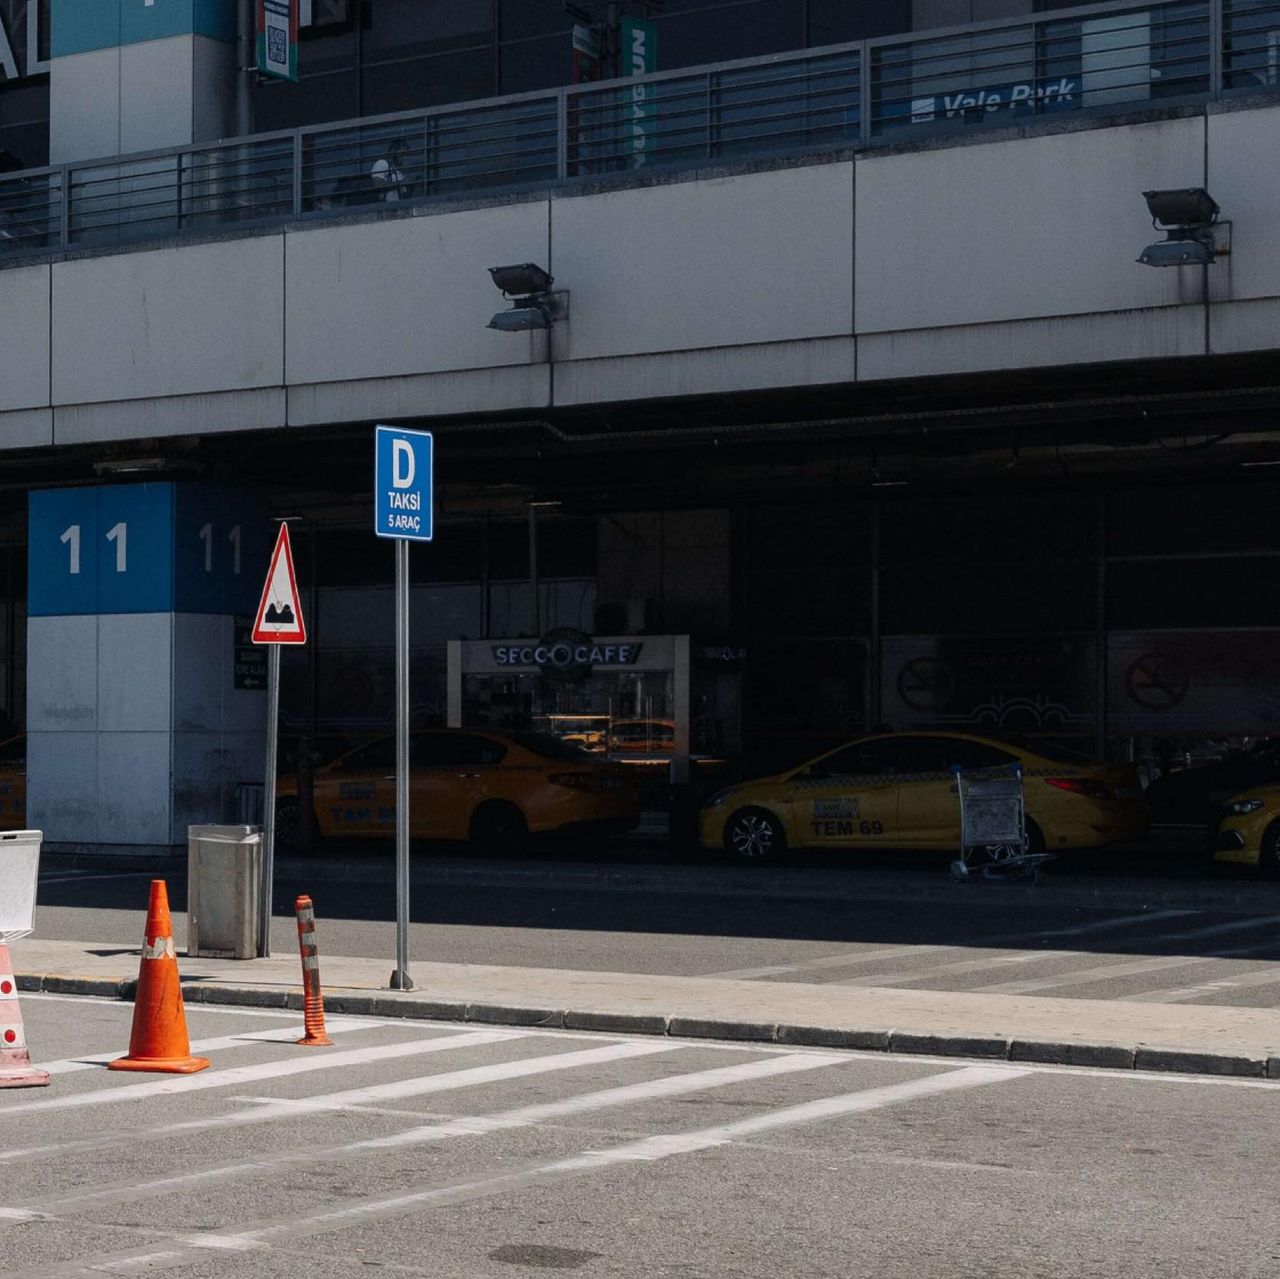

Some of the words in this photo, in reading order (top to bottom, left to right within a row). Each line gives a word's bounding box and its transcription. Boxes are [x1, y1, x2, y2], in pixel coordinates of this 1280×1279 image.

[943, 90, 1002, 118] Vale
[1008, 77, 1075, 109] Park
[393, 439, 416, 489] D
[388, 491, 421, 511] TAKSİ
[388, 514, 394, 528] 5
[395, 515, 421, 533] ARAÇ
[574, 645, 631, 664] CAFE
[811, 820, 853, 836] TEM
[860, 820, 884, 835] 69
